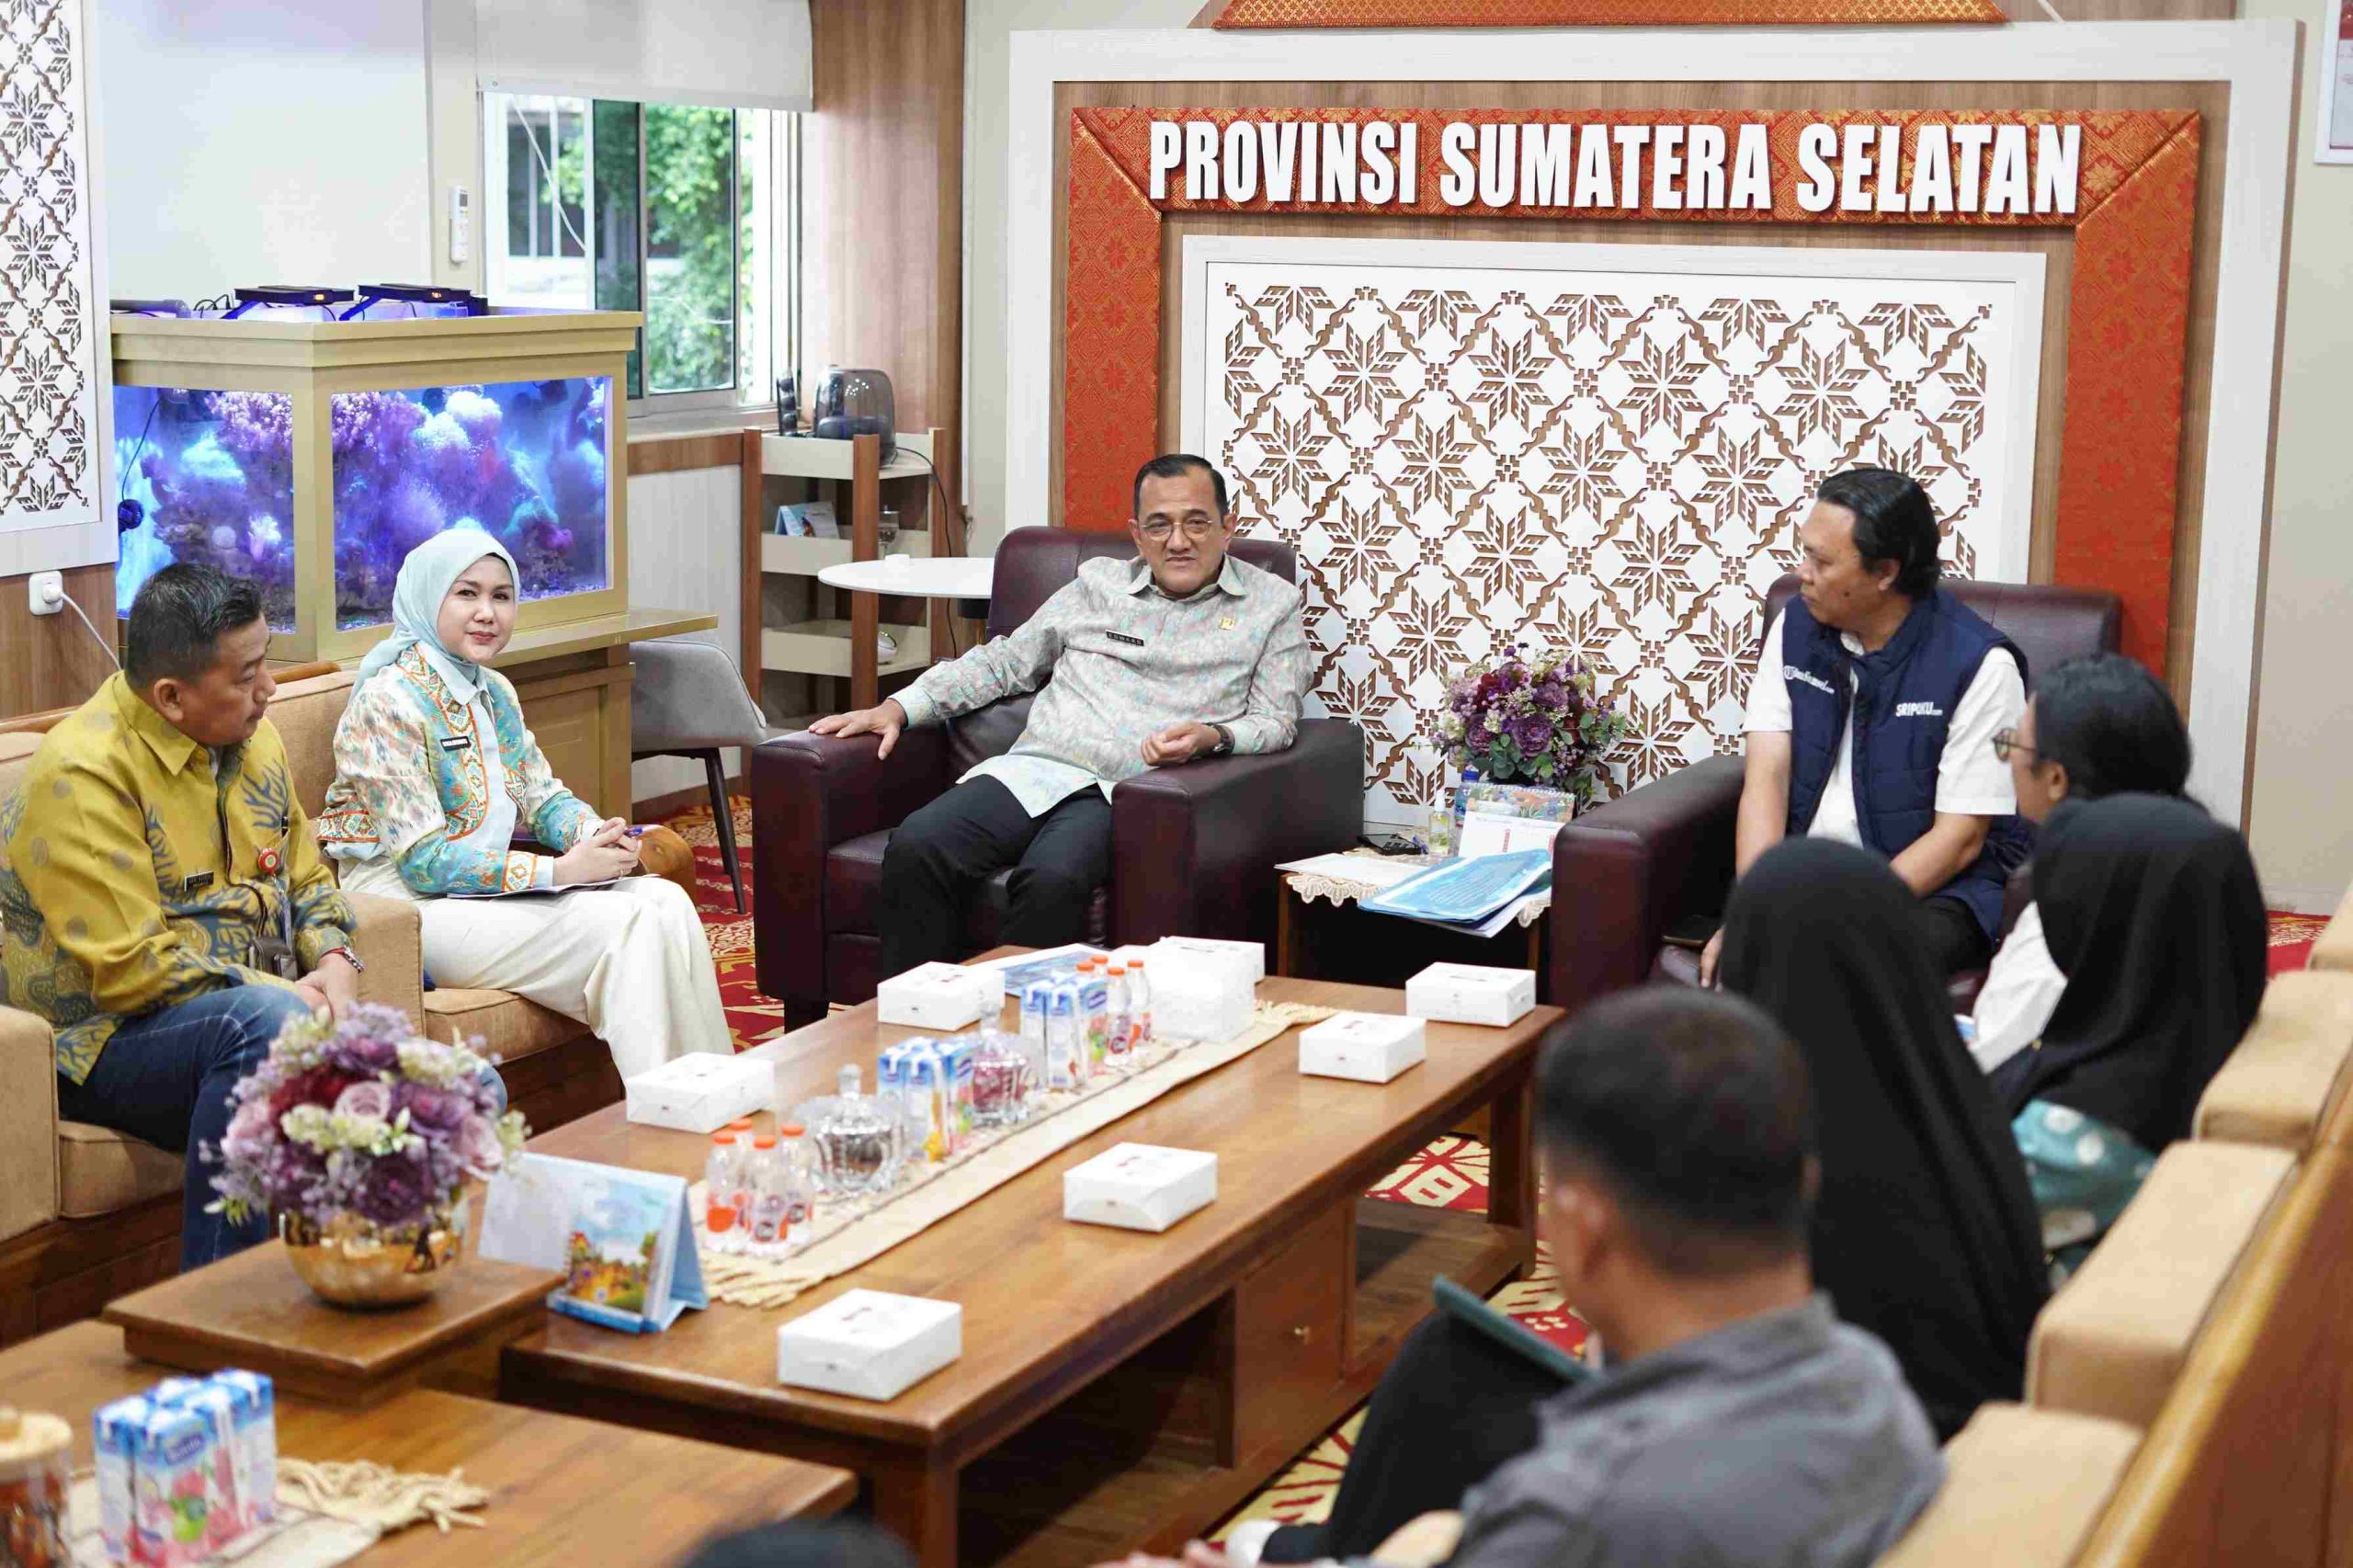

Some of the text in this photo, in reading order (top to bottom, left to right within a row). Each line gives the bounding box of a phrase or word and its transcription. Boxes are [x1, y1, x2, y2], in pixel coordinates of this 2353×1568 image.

[1150, 120, 2081, 213] PROVINSI SUMATERA SELATAN
